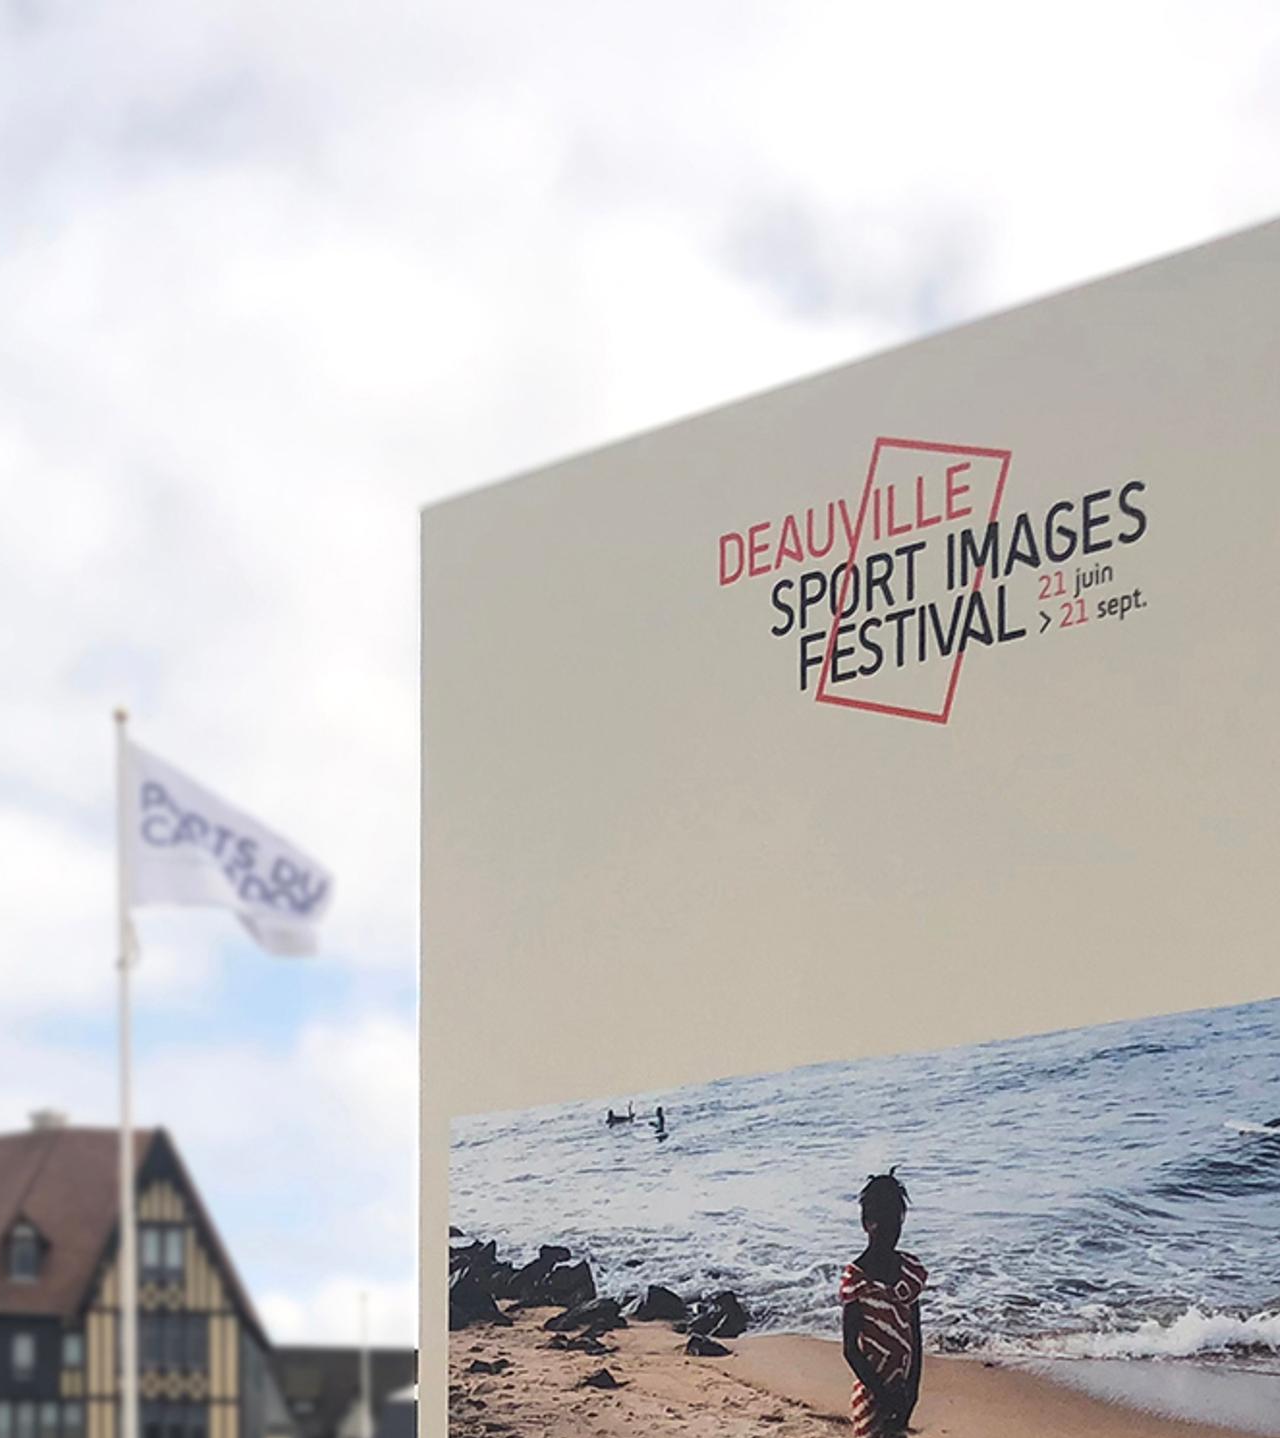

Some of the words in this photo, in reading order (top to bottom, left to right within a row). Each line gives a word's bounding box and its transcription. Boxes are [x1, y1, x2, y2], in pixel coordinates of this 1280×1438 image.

[720, 461, 973, 586] DEAUVILLE
[770, 541, 927, 637] SPORT
[946, 480, 1148, 591] IMAGES
[1038, 571, 1067, 601] 21
[1072, 562, 1114, 598] juin
[1059, 598, 1089, 629] 21
[1096, 587, 1148, 621] sept.
[799, 584, 1027, 691] FESTIVAL
